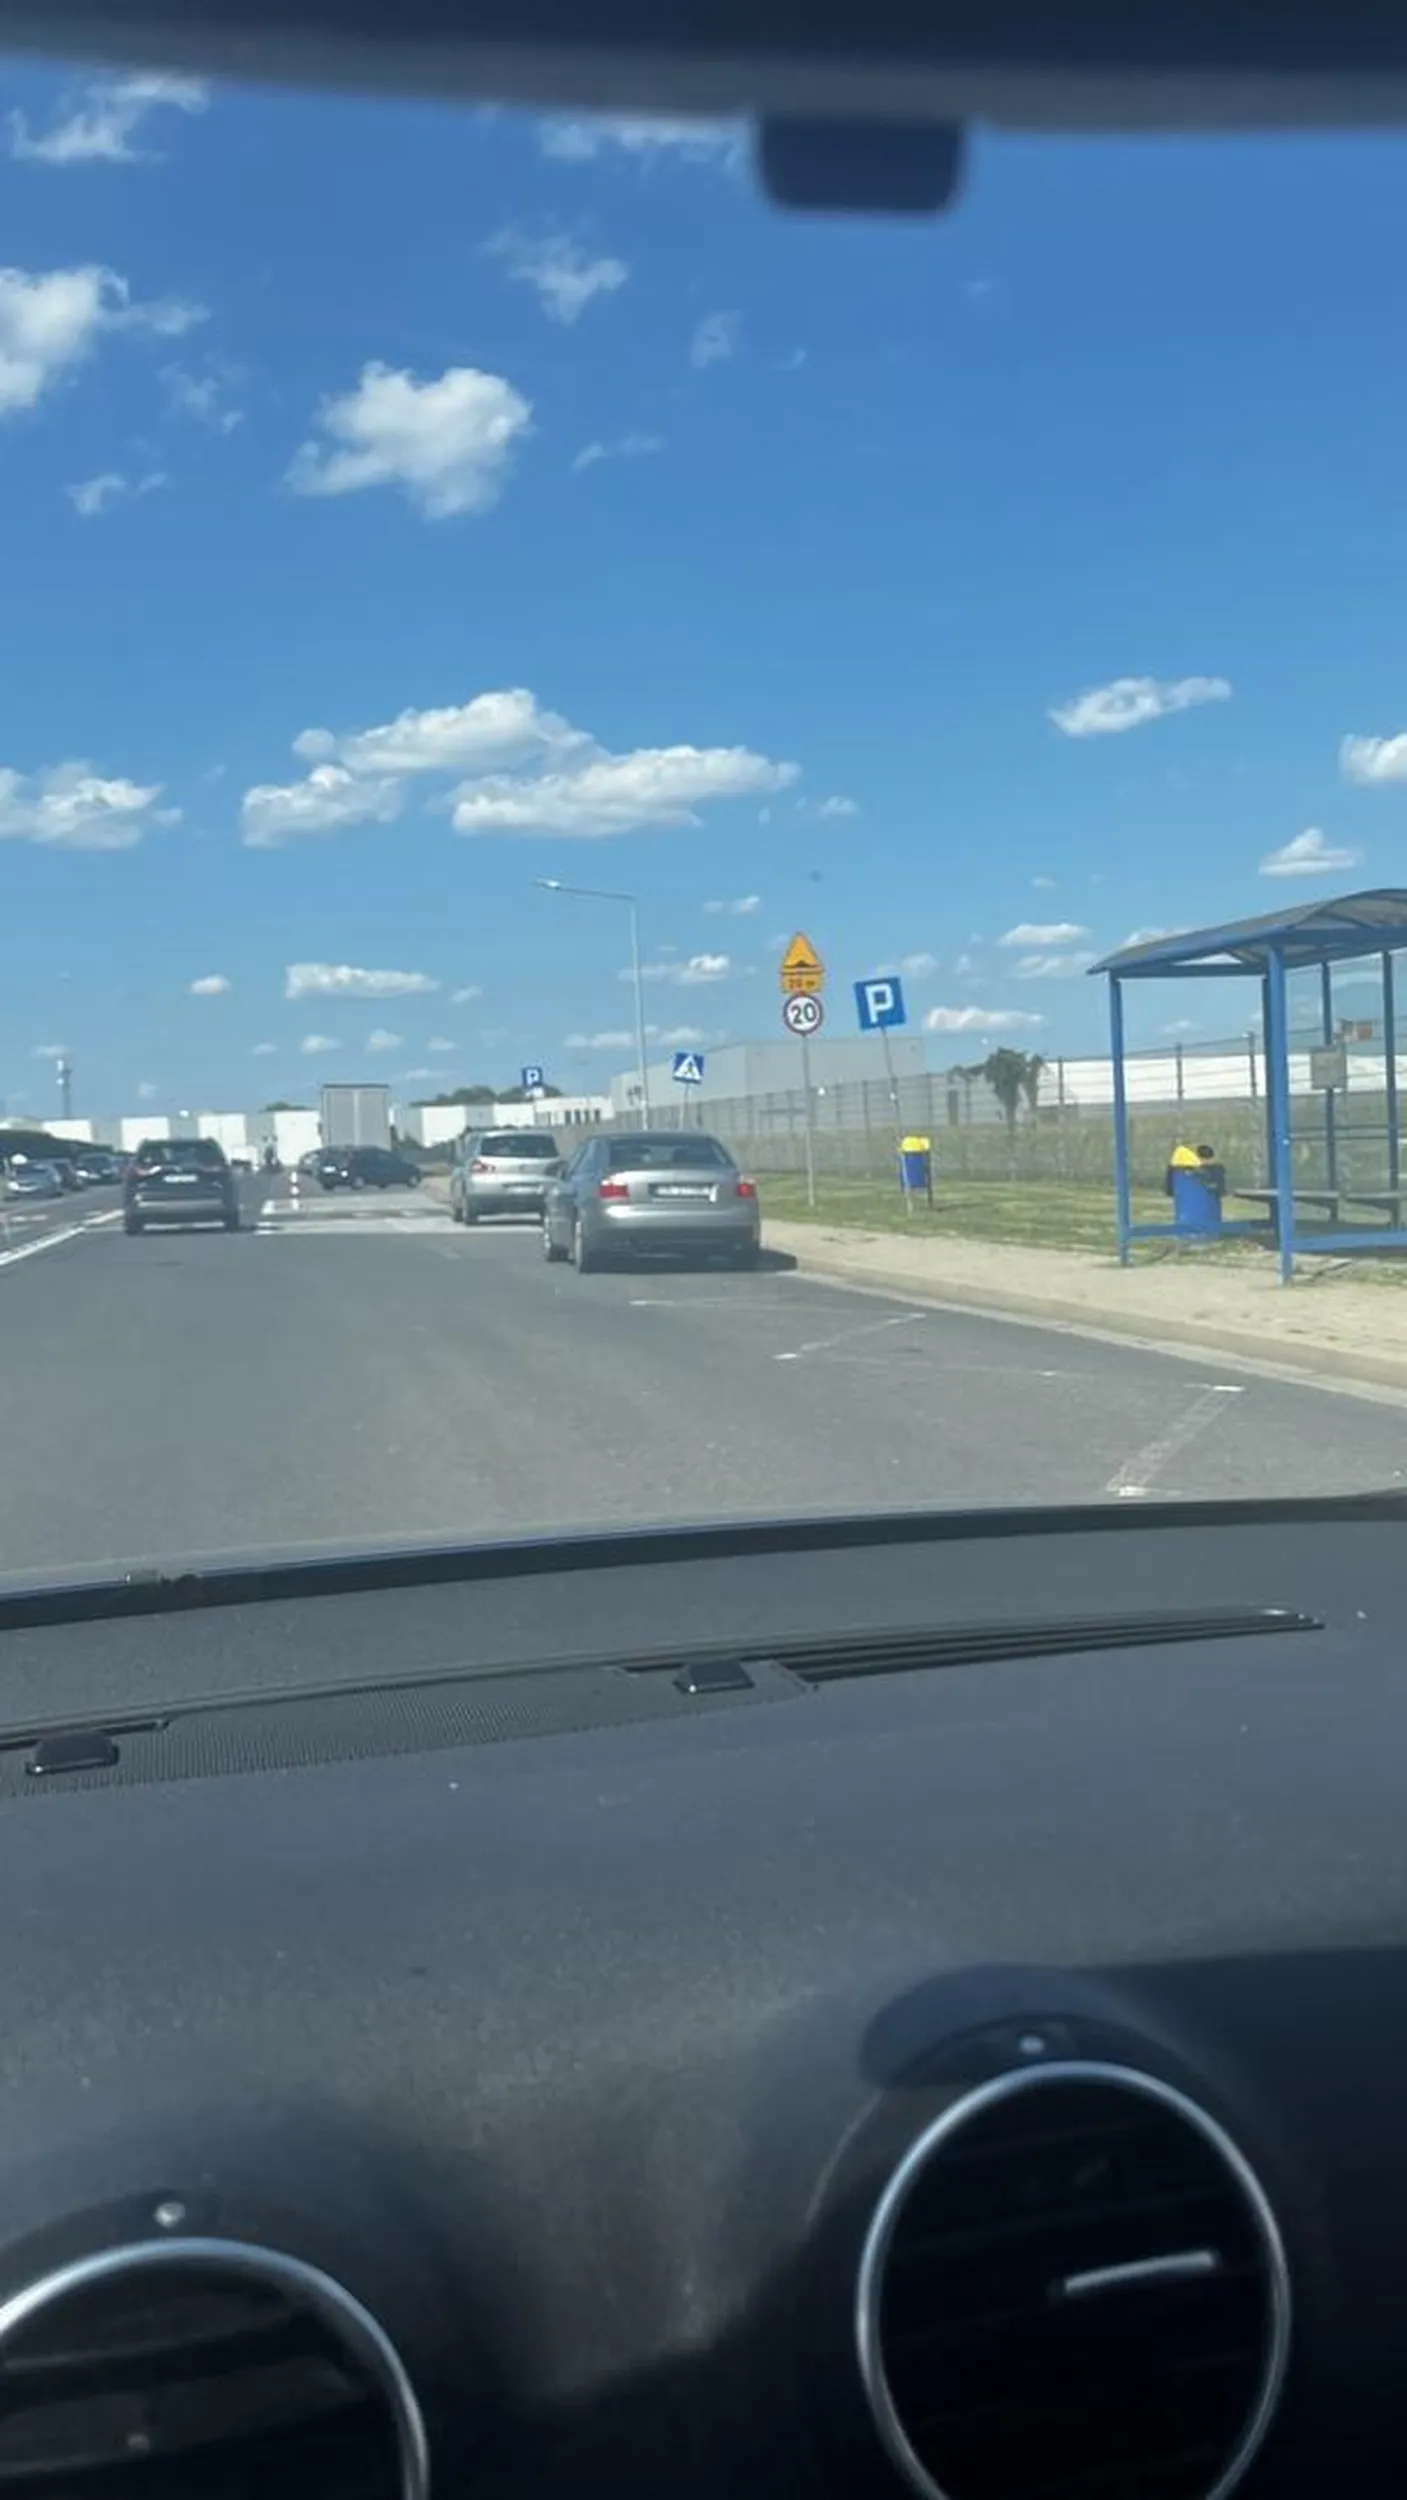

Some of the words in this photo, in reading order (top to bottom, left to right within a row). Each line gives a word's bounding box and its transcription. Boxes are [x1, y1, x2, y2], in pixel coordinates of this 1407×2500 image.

[791, 1003, 817, 1024] 20
[865, 984, 894, 1023] P
[527, 1069, 540, 1085] P
